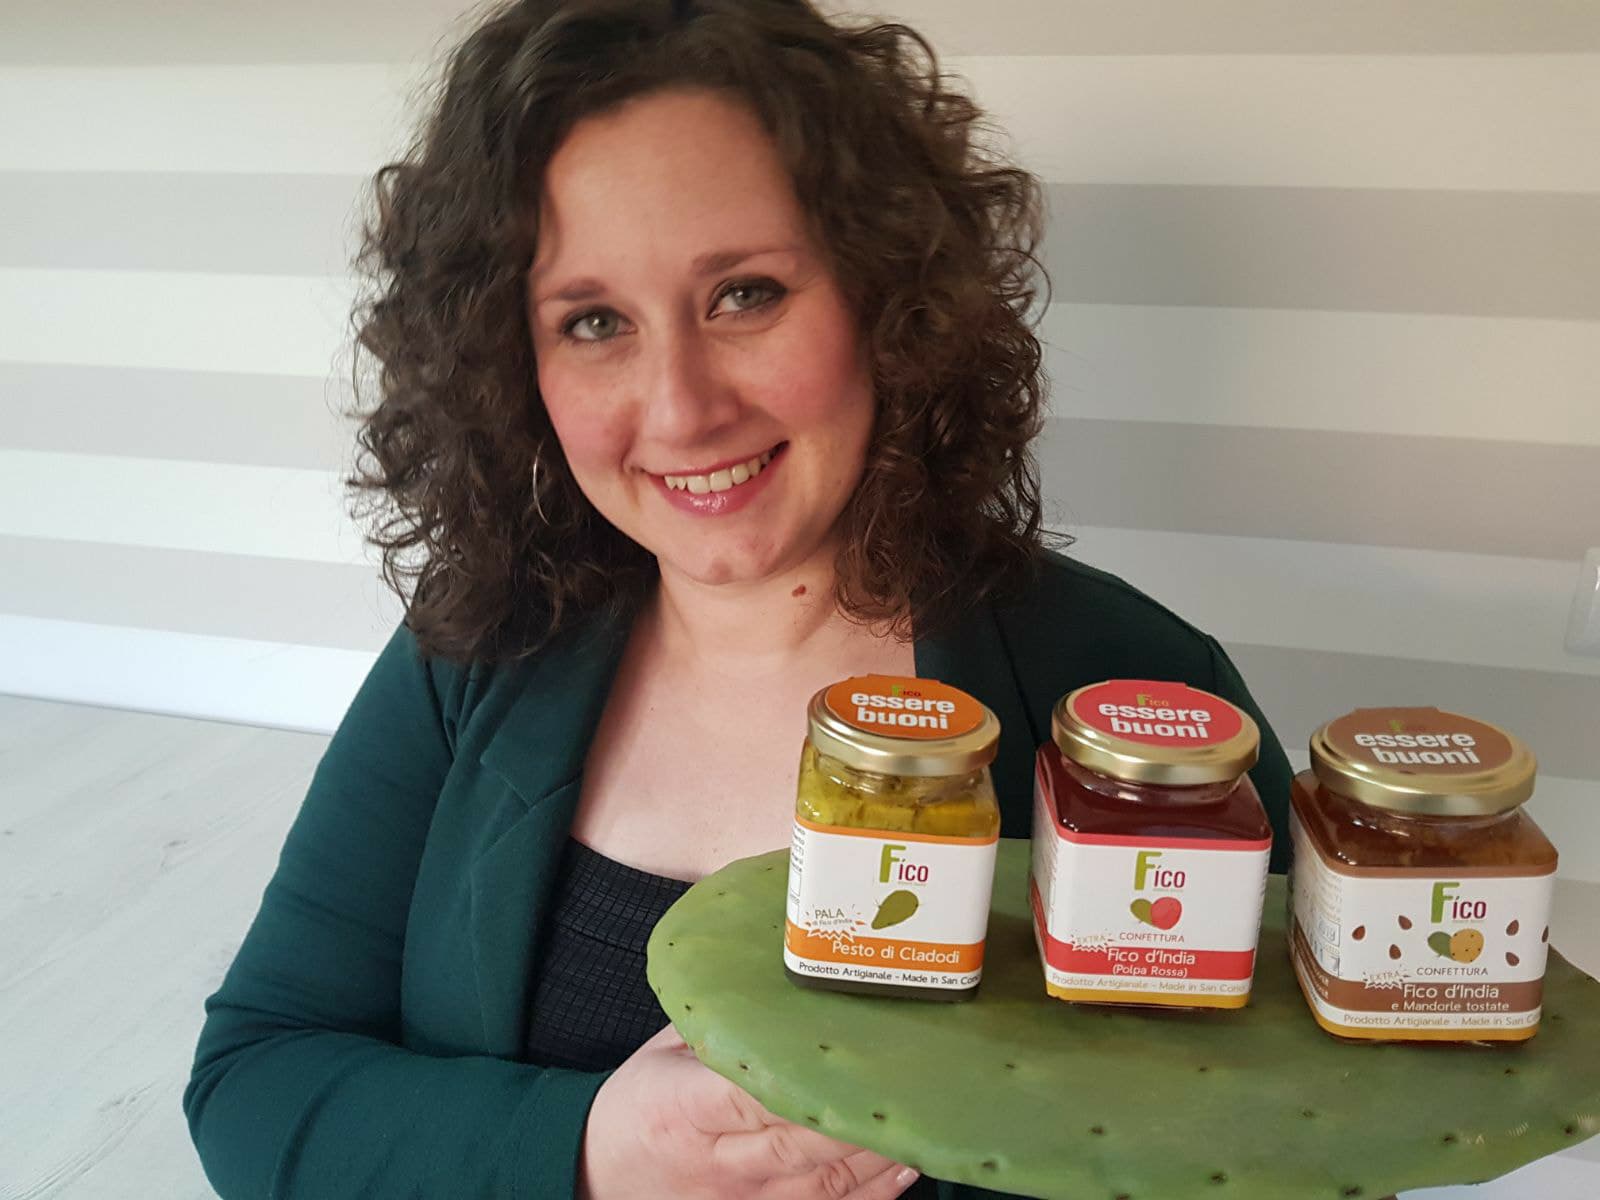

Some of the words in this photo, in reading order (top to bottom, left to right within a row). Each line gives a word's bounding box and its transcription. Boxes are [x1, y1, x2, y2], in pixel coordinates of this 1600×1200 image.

[851, 692, 955, 714] essere
[857, 707, 948, 730] buoni
[1098, 703, 1211, 723] essere
[1111, 717, 1208, 738] buoni
[1354, 733, 1476, 748] essere
[1371, 747, 1480, 765] buoni
[879, 843, 929, 883] Fico
[1133, 850, 1186, 891] Fico
[1430, 881, 1487, 924] Fico
[814, 908, 845, 919] PALA
[1119, 932, 1185, 943] CONFETTURA
[833, 941, 875, 957] Pesto
[881, 945, 894, 959] di
[899, 947, 960, 964] Cladodi
[1107, 948, 1139, 962] Fico
[1145, 949, 1196, 965] d'India
[799, 961, 840, 975] Prodotto
[841, 967, 892, 981] Artigianale
[902, 973, 928, 983] Made
[930, 974, 938, 984] in
[941, 975, 957, 985] San
[1112, 965, 1147, 977] (Polpa
[1151, 966, 1188, 978] Rossa)
[1416, 967, 1489, 977] CONFETTURA
[1052, 973, 1094, 987] Prodotto
[1096, 977, 1149, 990] Artigianale
[1159, 981, 1186, 991] Made
[1188, 981, 1197, 992] in
[1200, 983, 1217, 992] San
[1403, 983, 1437, 999] Fico
[1444, 984, 1499, 999] d'India
[1391, 1003, 1399, 1011] e
[1403, 1001, 1461, 1012] Mandorle
[1466, 1001, 1510, 1012] tostate
[1344, 1013, 1391, 1025] Prodotto
[1393, 1015, 1450, 1027] Artigianale
[1461, 1015, 1490, 1026] Made
[1493, 1016, 1503, 1025] in
[1505, 1016, 1524, 1026] San
